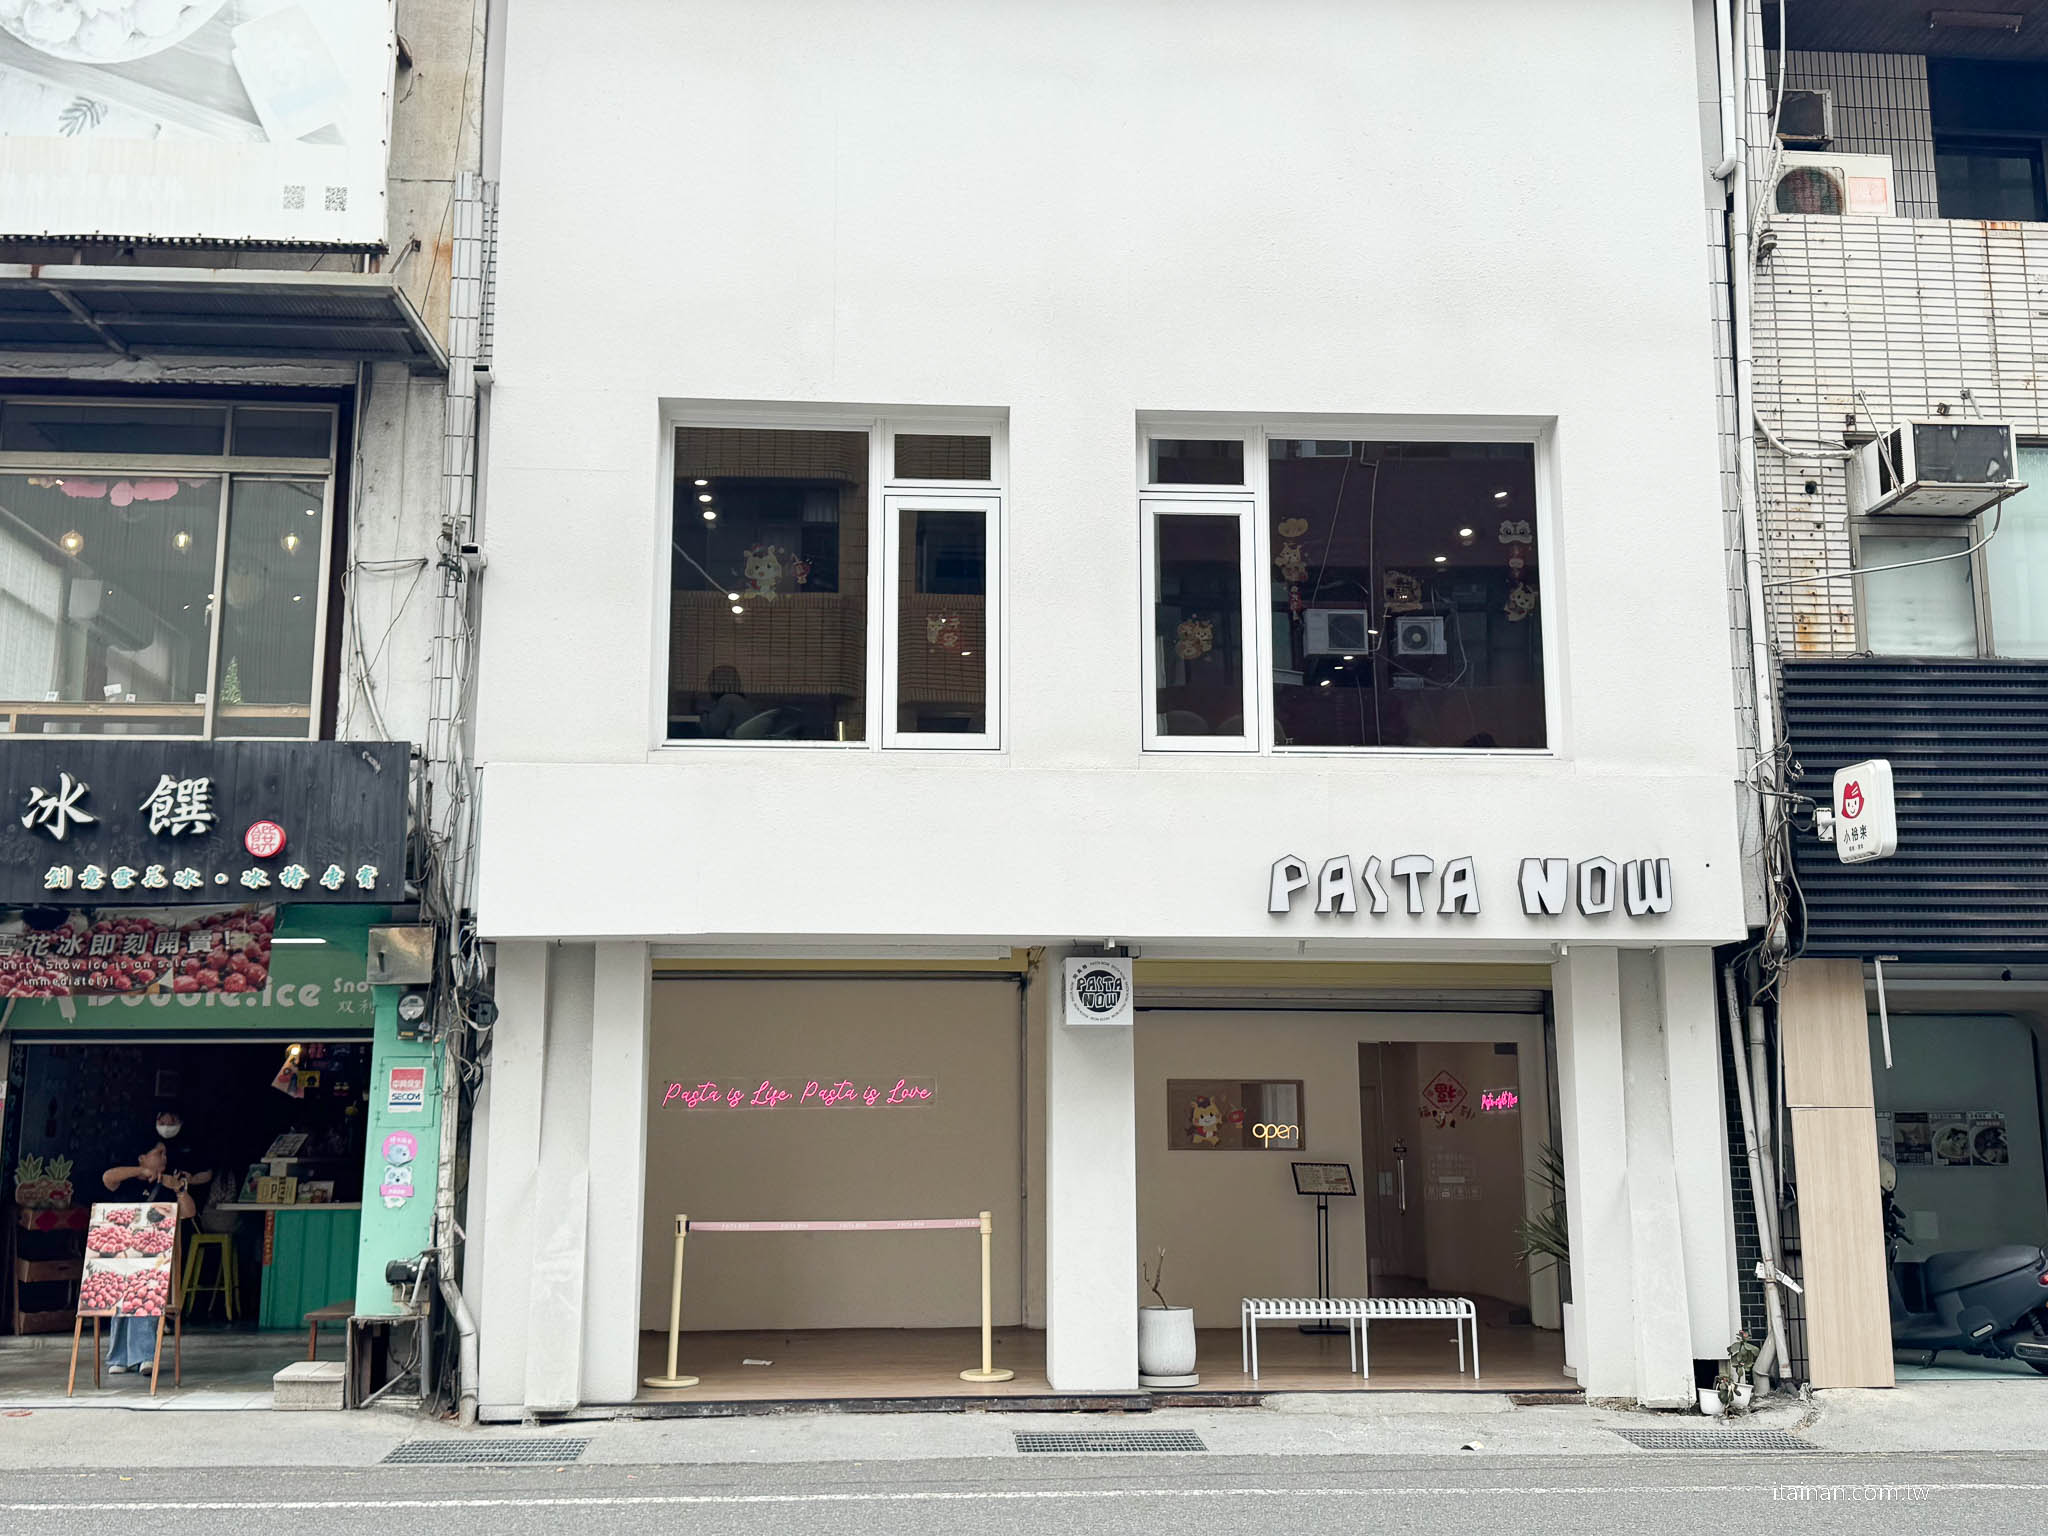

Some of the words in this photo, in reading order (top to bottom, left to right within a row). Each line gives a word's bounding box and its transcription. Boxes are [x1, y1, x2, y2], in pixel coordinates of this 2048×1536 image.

[21, 771, 216, 840] 冰饌
[1267, 853, 1481, 916] PASTA
[1518, 855, 1674, 917] NOW
[134, 960, 151, 969] on
[157, 958, 188, 969] sale
[333, 977, 372, 993] Sno
[1076, 975, 1123, 992] PASTA
[1082, 992, 1118, 1009] NOW
[391, 1092, 421, 1101] SECOM
[662, 1080, 722, 1108] Pasta
[726, 1086, 745, 1108] is
[800, 1079, 858, 1107] Pasta
[863, 1085, 881, 1107] is
[886, 1078, 933, 1105] Love
[1252, 1123, 1299, 1149] open
